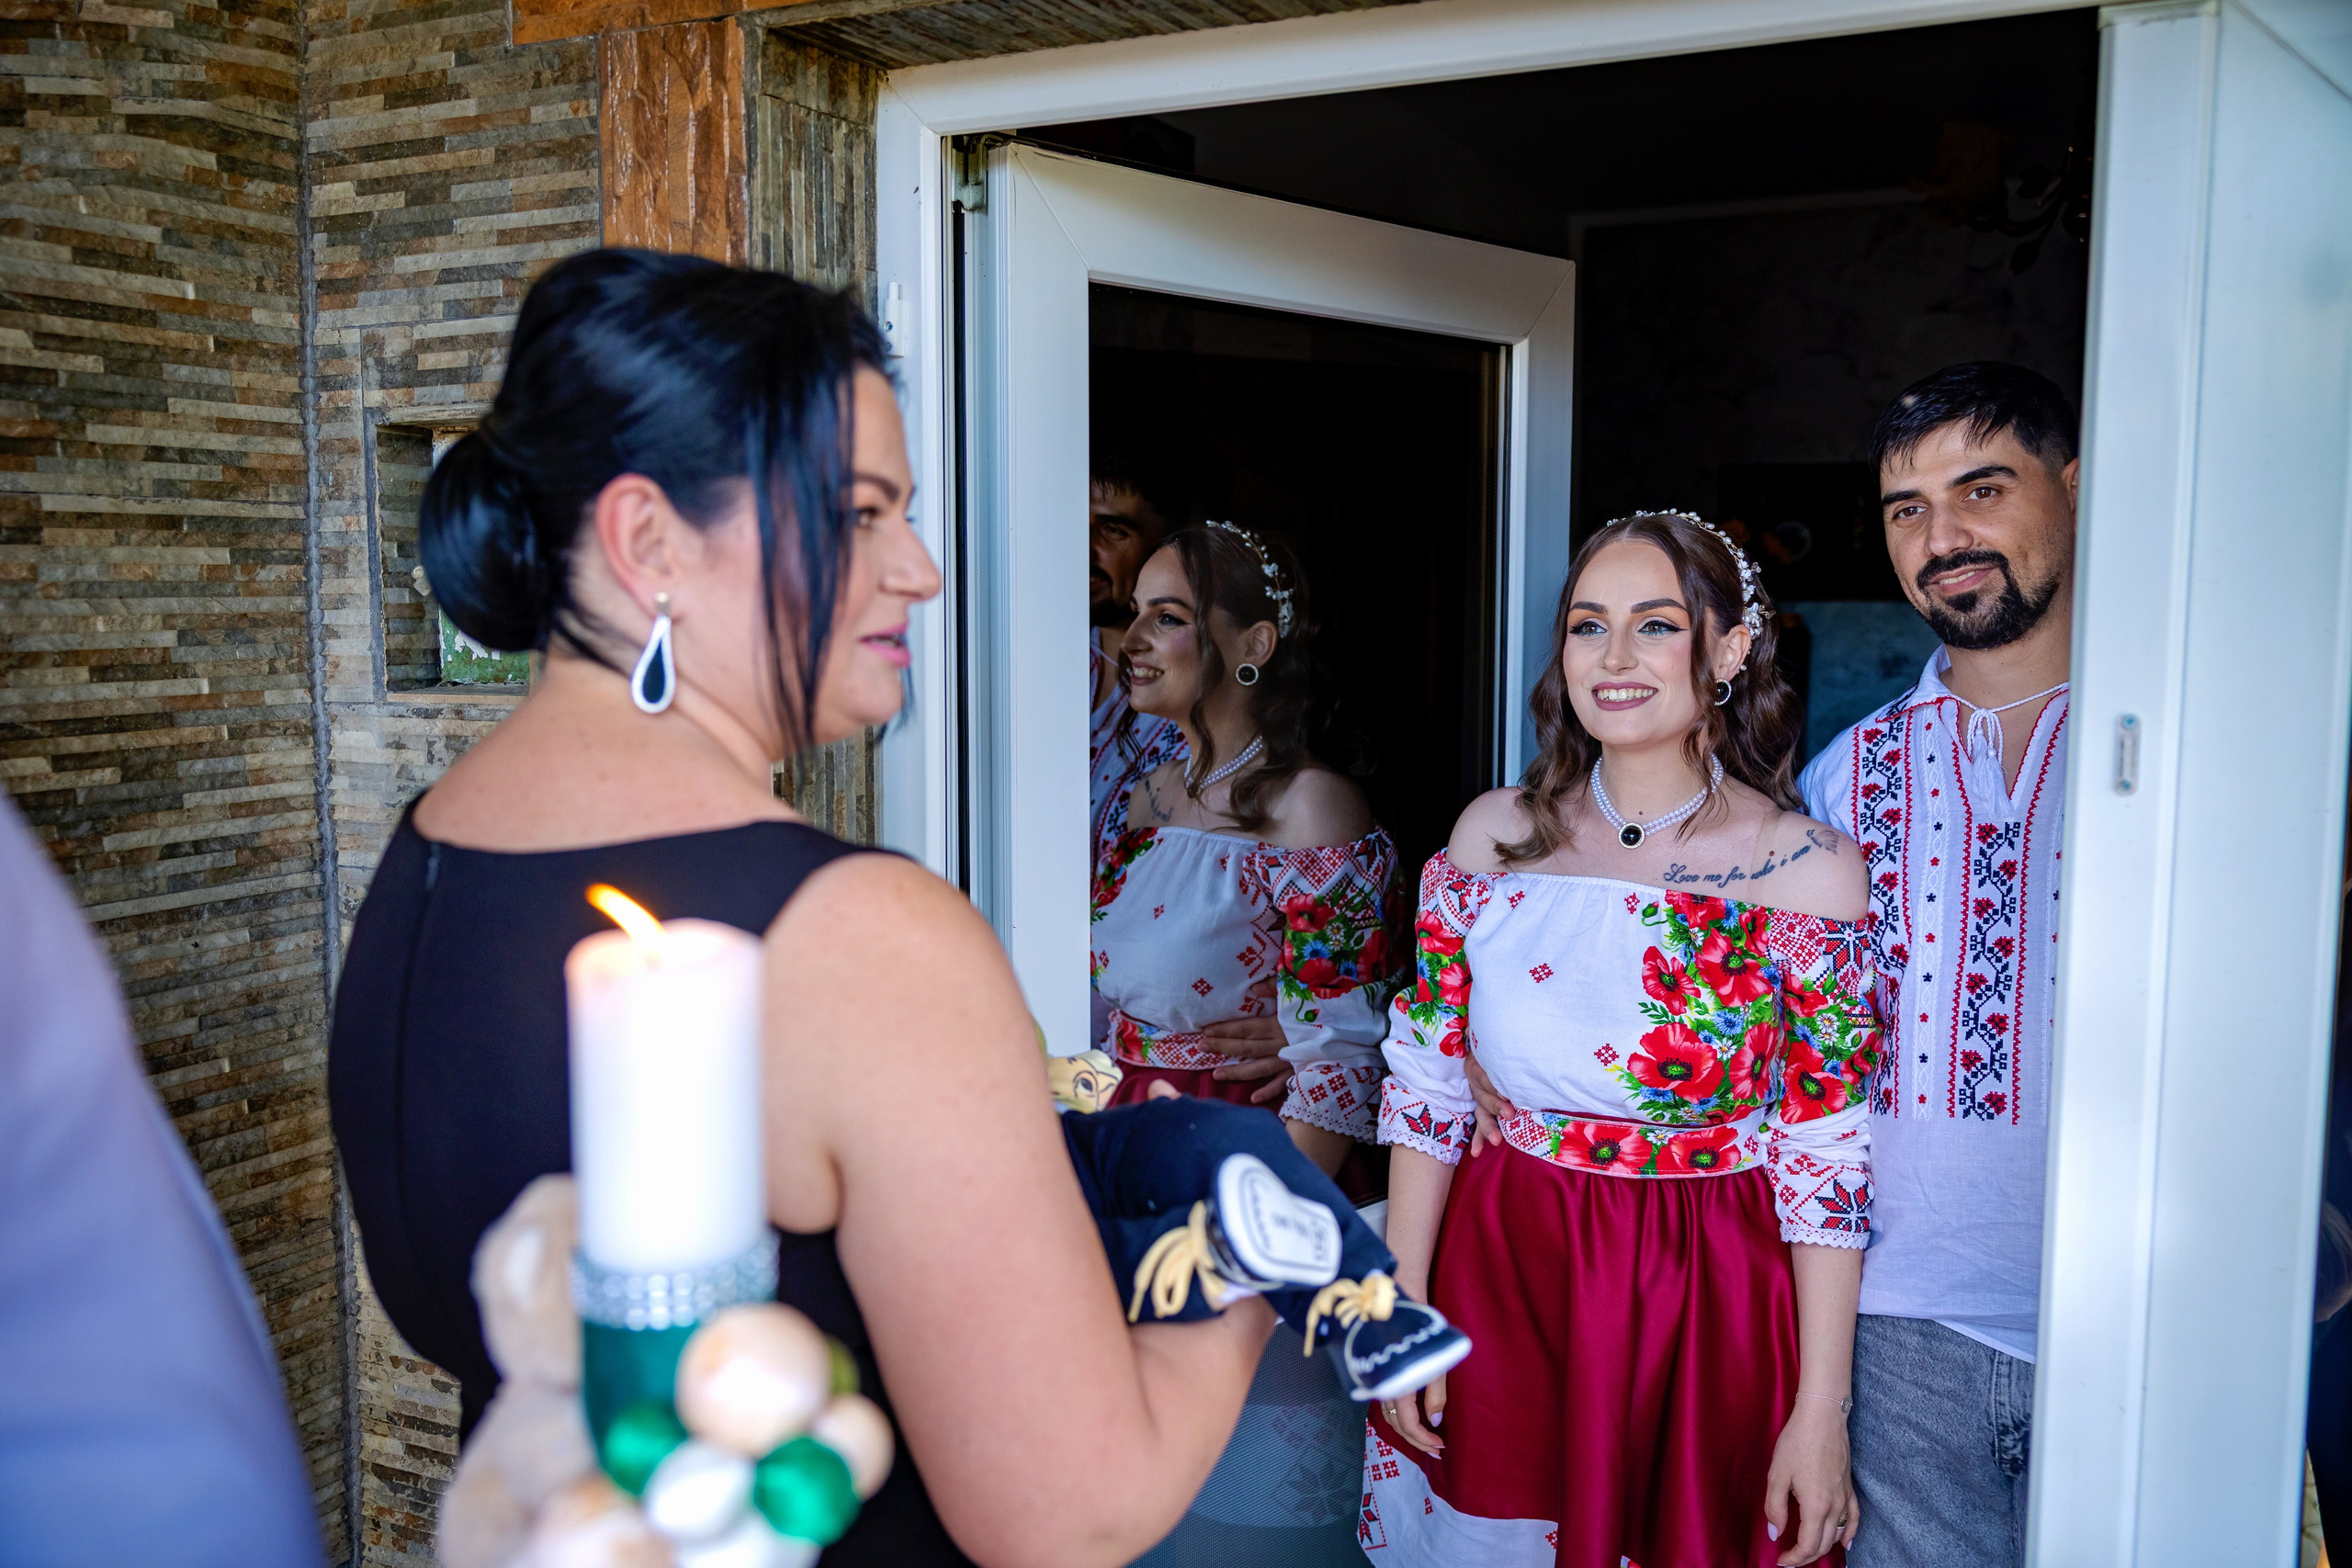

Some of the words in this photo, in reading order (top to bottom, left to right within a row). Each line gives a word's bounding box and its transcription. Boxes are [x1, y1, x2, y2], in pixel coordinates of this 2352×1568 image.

[1663, 863, 1700, 884] Love
[1702, 873, 1723, 882] me
[1717, 865, 1747, 888] for
[1750, 858, 1777, 880] who
[1791, 844, 1812, 862] am
